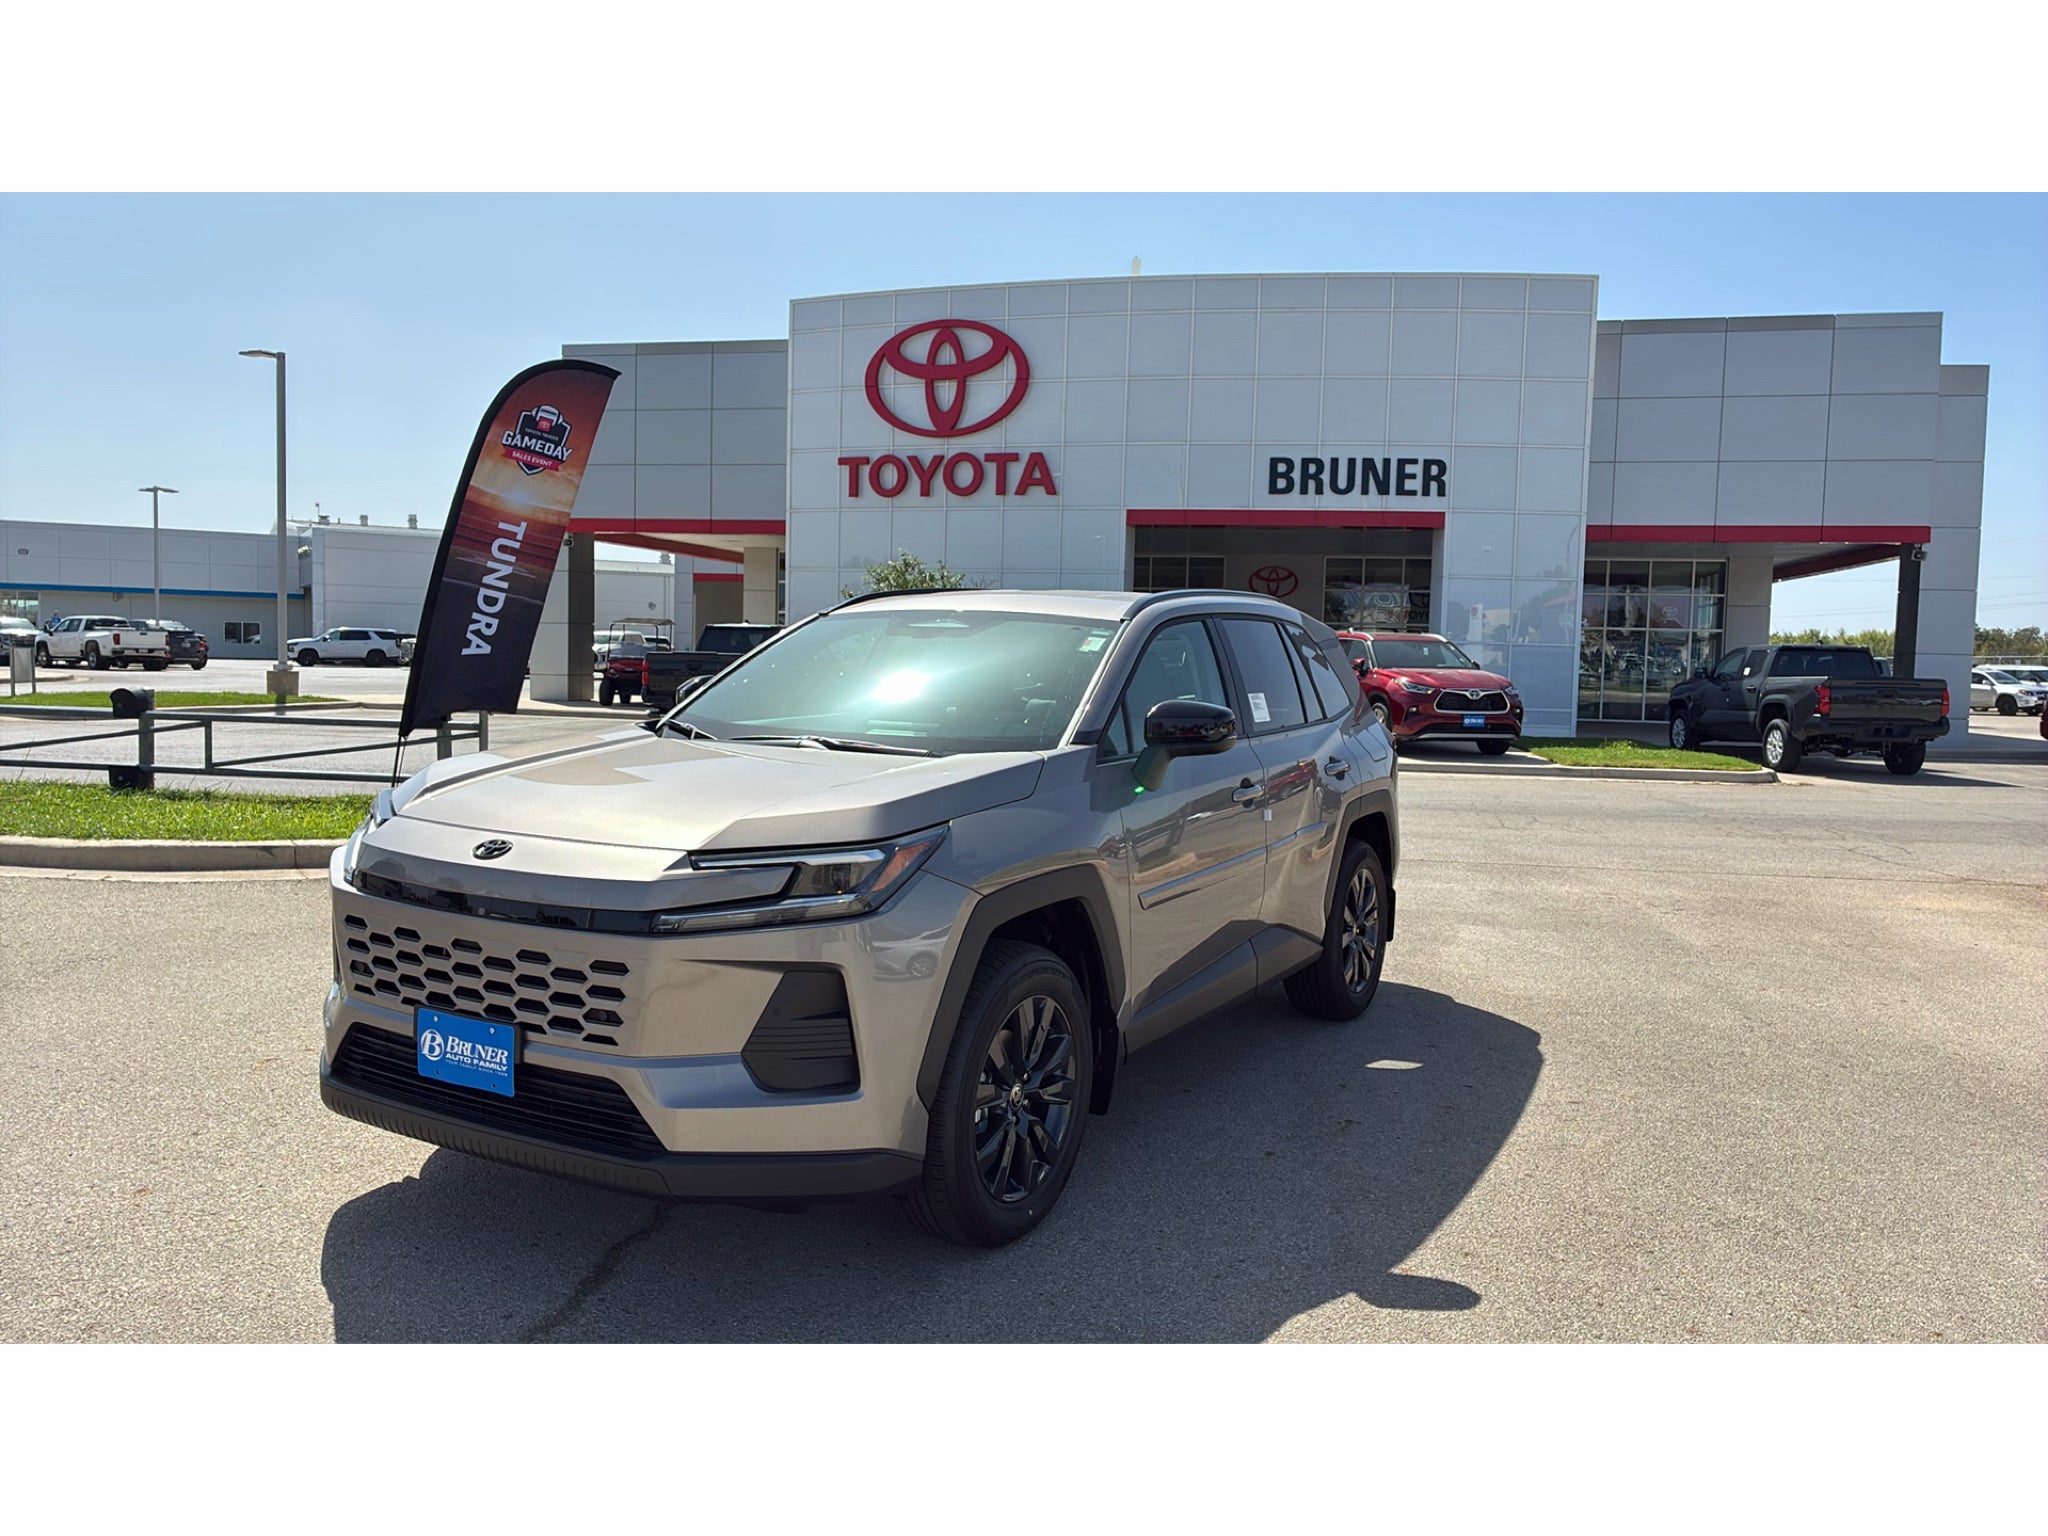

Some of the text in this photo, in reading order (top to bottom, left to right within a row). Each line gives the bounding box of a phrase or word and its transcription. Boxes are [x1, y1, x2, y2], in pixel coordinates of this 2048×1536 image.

[502, 430, 573, 461] GAMEDAY
[512, 451, 553, 467] SALES EVENT
[838, 452, 1057, 497] TOYOTA
[1268, 457, 1447, 498] BRUNER
[461, 520, 527, 656] TUNDRA
[445, 1052, 508, 1071] AUTO FAMILY
[446, 1035, 509, 1065] BRUNER
